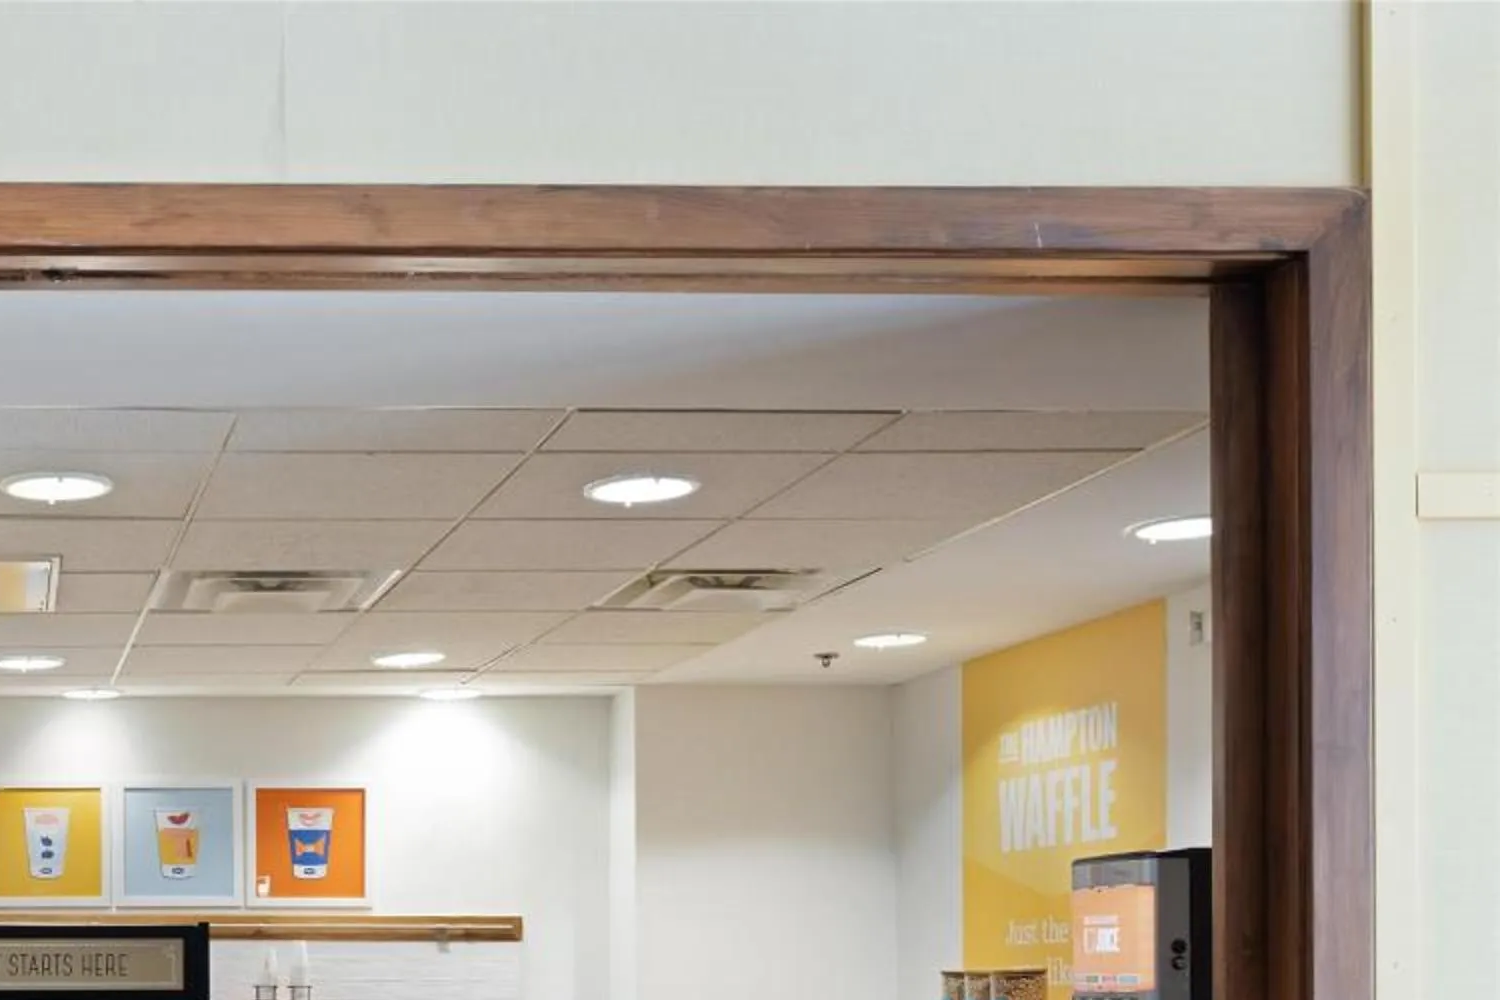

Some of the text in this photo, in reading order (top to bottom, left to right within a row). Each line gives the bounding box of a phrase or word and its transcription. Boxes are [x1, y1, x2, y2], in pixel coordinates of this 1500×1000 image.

[1021, 702, 1118, 766] HAMPTON
[1000, 760, 1118, 852] WAFFLE
[1006, 919, 1037, 946] Just
[1042, 915, 1070, 944] the
[7, 953, 73, 977] STARTS
[81, 953, 127, 977] HERE
